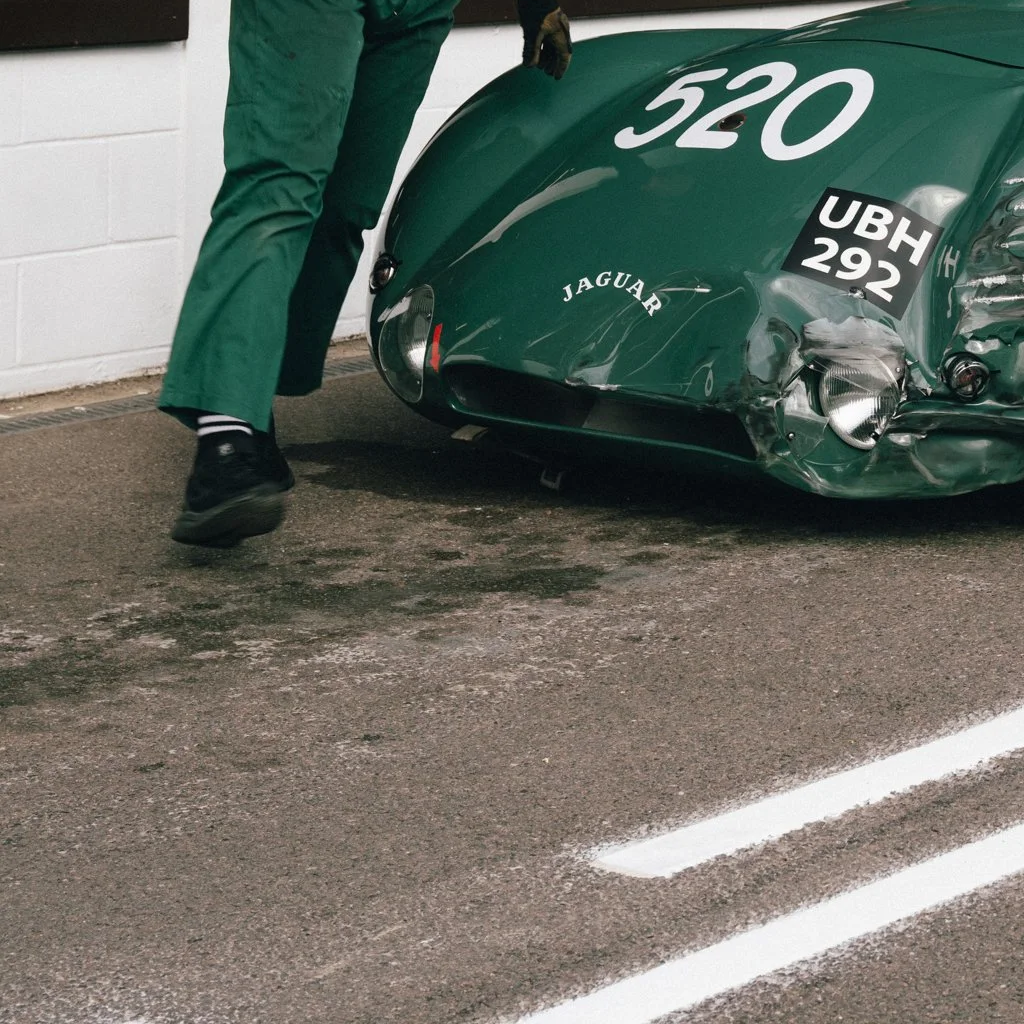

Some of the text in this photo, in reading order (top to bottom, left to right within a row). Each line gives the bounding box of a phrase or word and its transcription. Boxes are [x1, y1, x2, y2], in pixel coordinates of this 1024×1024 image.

[613, 61, 875, 161] 520
[818, 195, 933, 267] UBH
[562, 271, 662, 317] JAGUAR
[800, 237, 901, 303] 292
